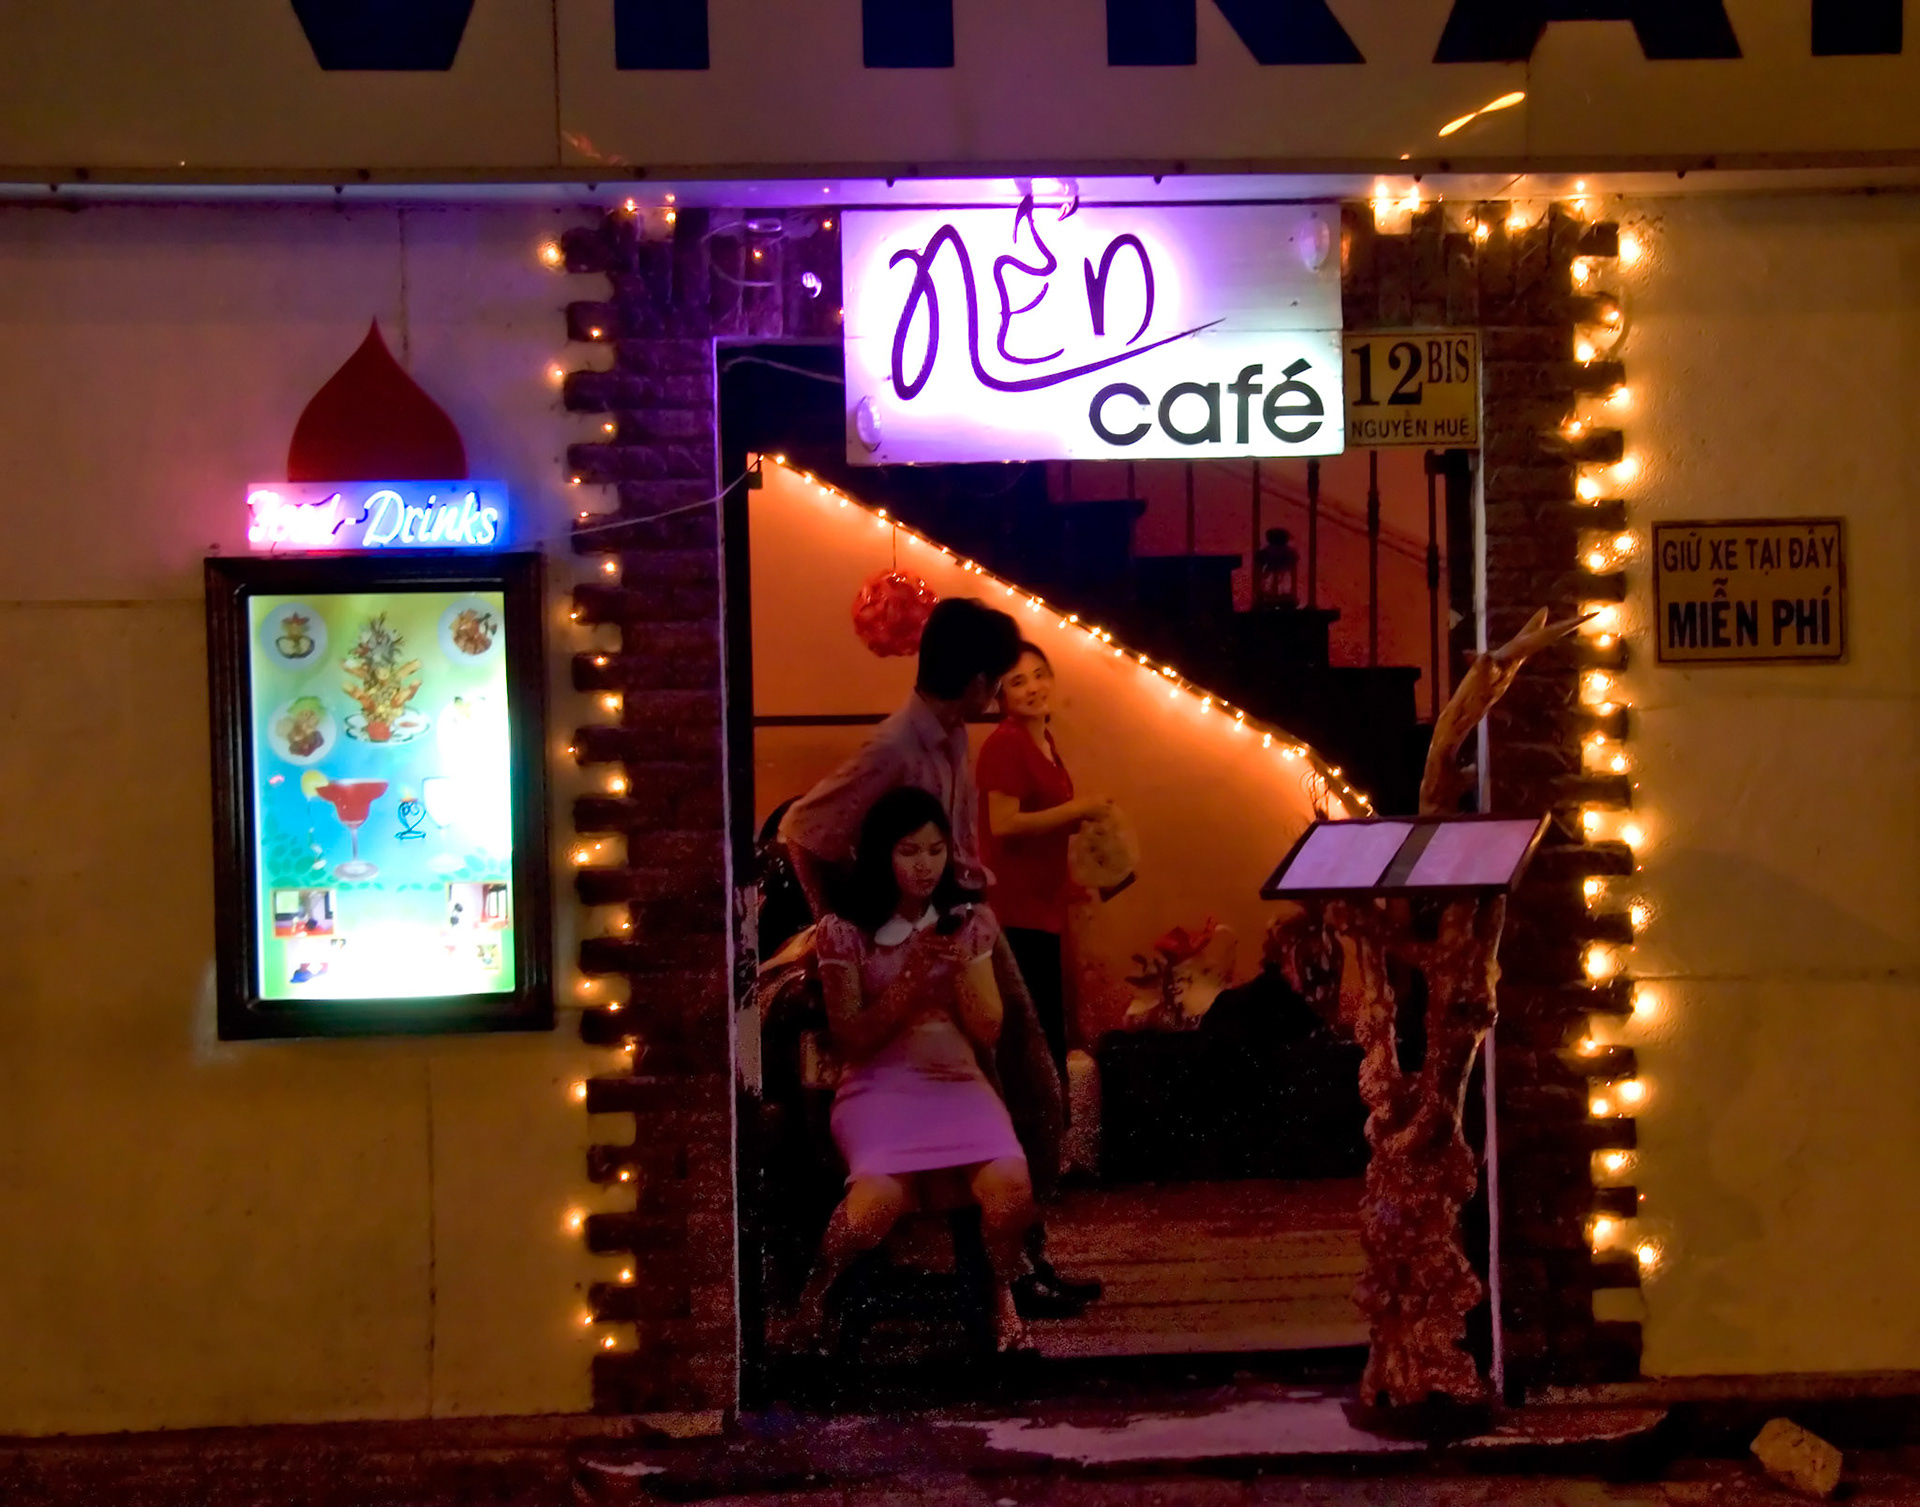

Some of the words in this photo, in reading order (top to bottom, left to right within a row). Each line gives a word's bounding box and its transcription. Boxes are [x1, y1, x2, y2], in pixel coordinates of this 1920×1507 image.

[1089, 358, 1325, 445] café
[1351, 341, 1422, 406] 12
[1426, 339, 1470, 384] BIS
[362, 489, 498, 546] Drinks
[1709, 538, 1738, 571] XE
[1745, 537, 1781, 576] TẠI
[1668, 577, 1759, 649] MIỄN
[1772, 585, 1832, 647] PHÍ
